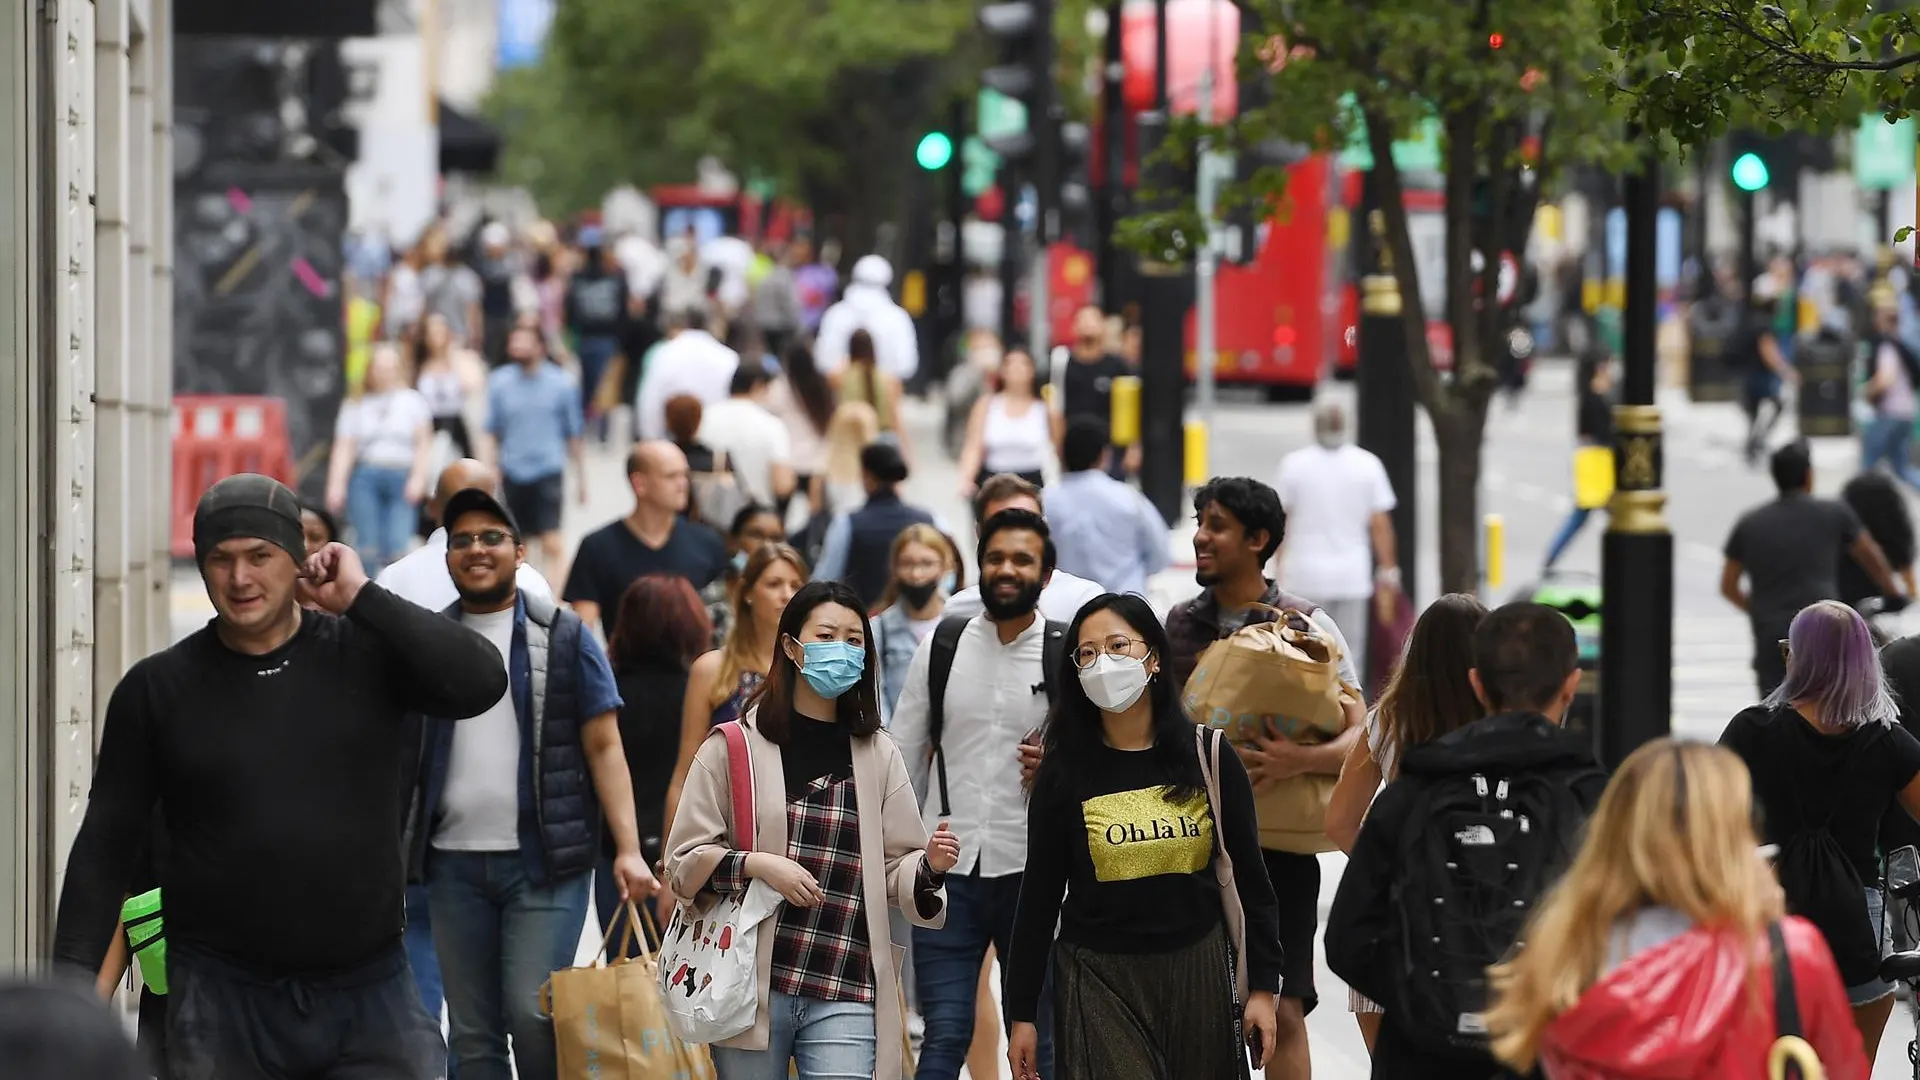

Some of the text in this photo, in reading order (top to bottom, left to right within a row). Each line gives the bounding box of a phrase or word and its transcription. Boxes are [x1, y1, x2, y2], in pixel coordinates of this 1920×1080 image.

[1106, 816, 1201, 845] Oh là là
